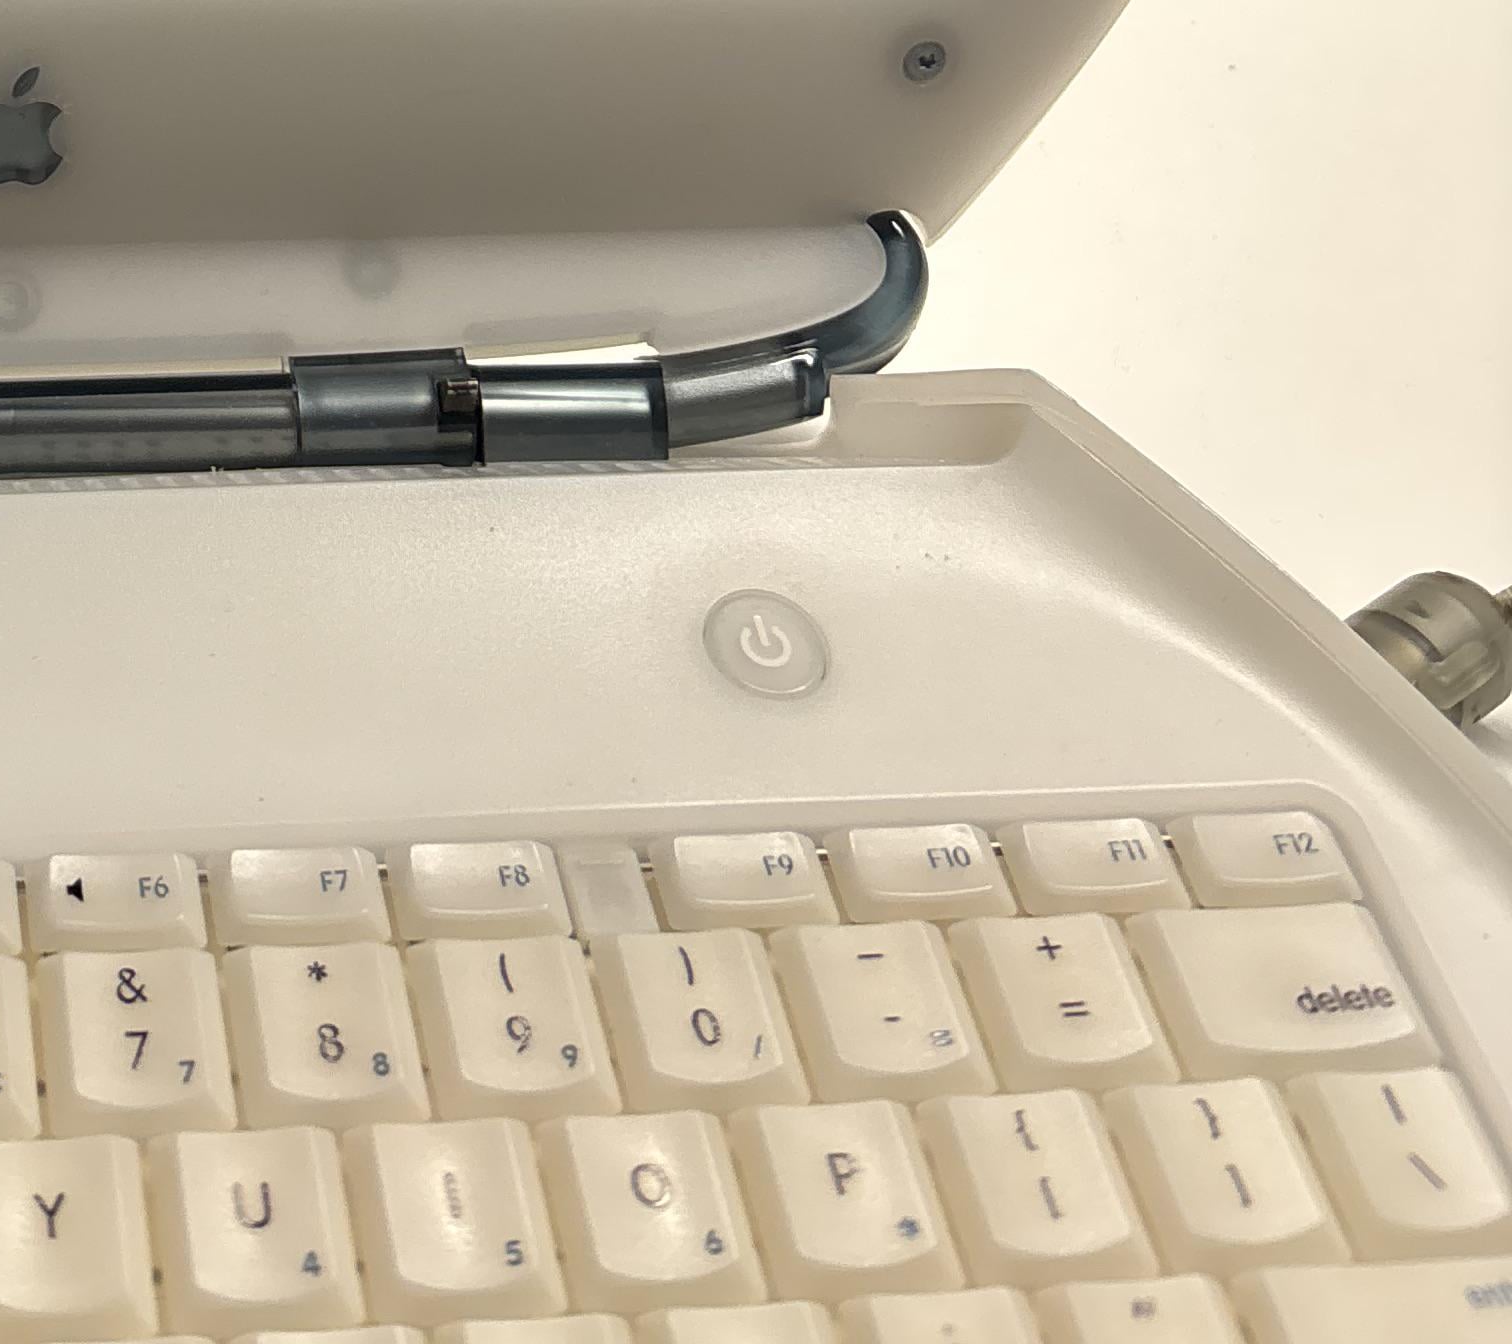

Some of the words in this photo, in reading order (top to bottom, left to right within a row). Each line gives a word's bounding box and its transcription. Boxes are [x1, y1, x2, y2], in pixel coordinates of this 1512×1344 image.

[1106, 837, 1148, 863] F11
[1272, 831, 1320, 858] F12
[762, 852, 795, 878] F9
[926, 844, 972, 872] F10
[138, 875, 170, 900] F6
[319, 867, 350, 893] F7
[498, 863, 531, 889] F8
[1296, 983, 1396, 1016] delete
[317, 1023, 345, 1064] 8
[505, 1015, 533, 1054] 9
[124, 1030, 149, 1070] 7
[561, 1044, 579, 1069] 9
[178, 1059, 196, 1085] 7
[372, 1052, 390, 1076] 8
[825, 1151, 861, 1196] P
[34, 1191, 65, 1239] Y
[231, 1181, 272, 1230] U
[505, 1240, 524, 1267] 5
[703, 1229, 724, 1255] 6
[301, 1250, 322, 1276] 4
